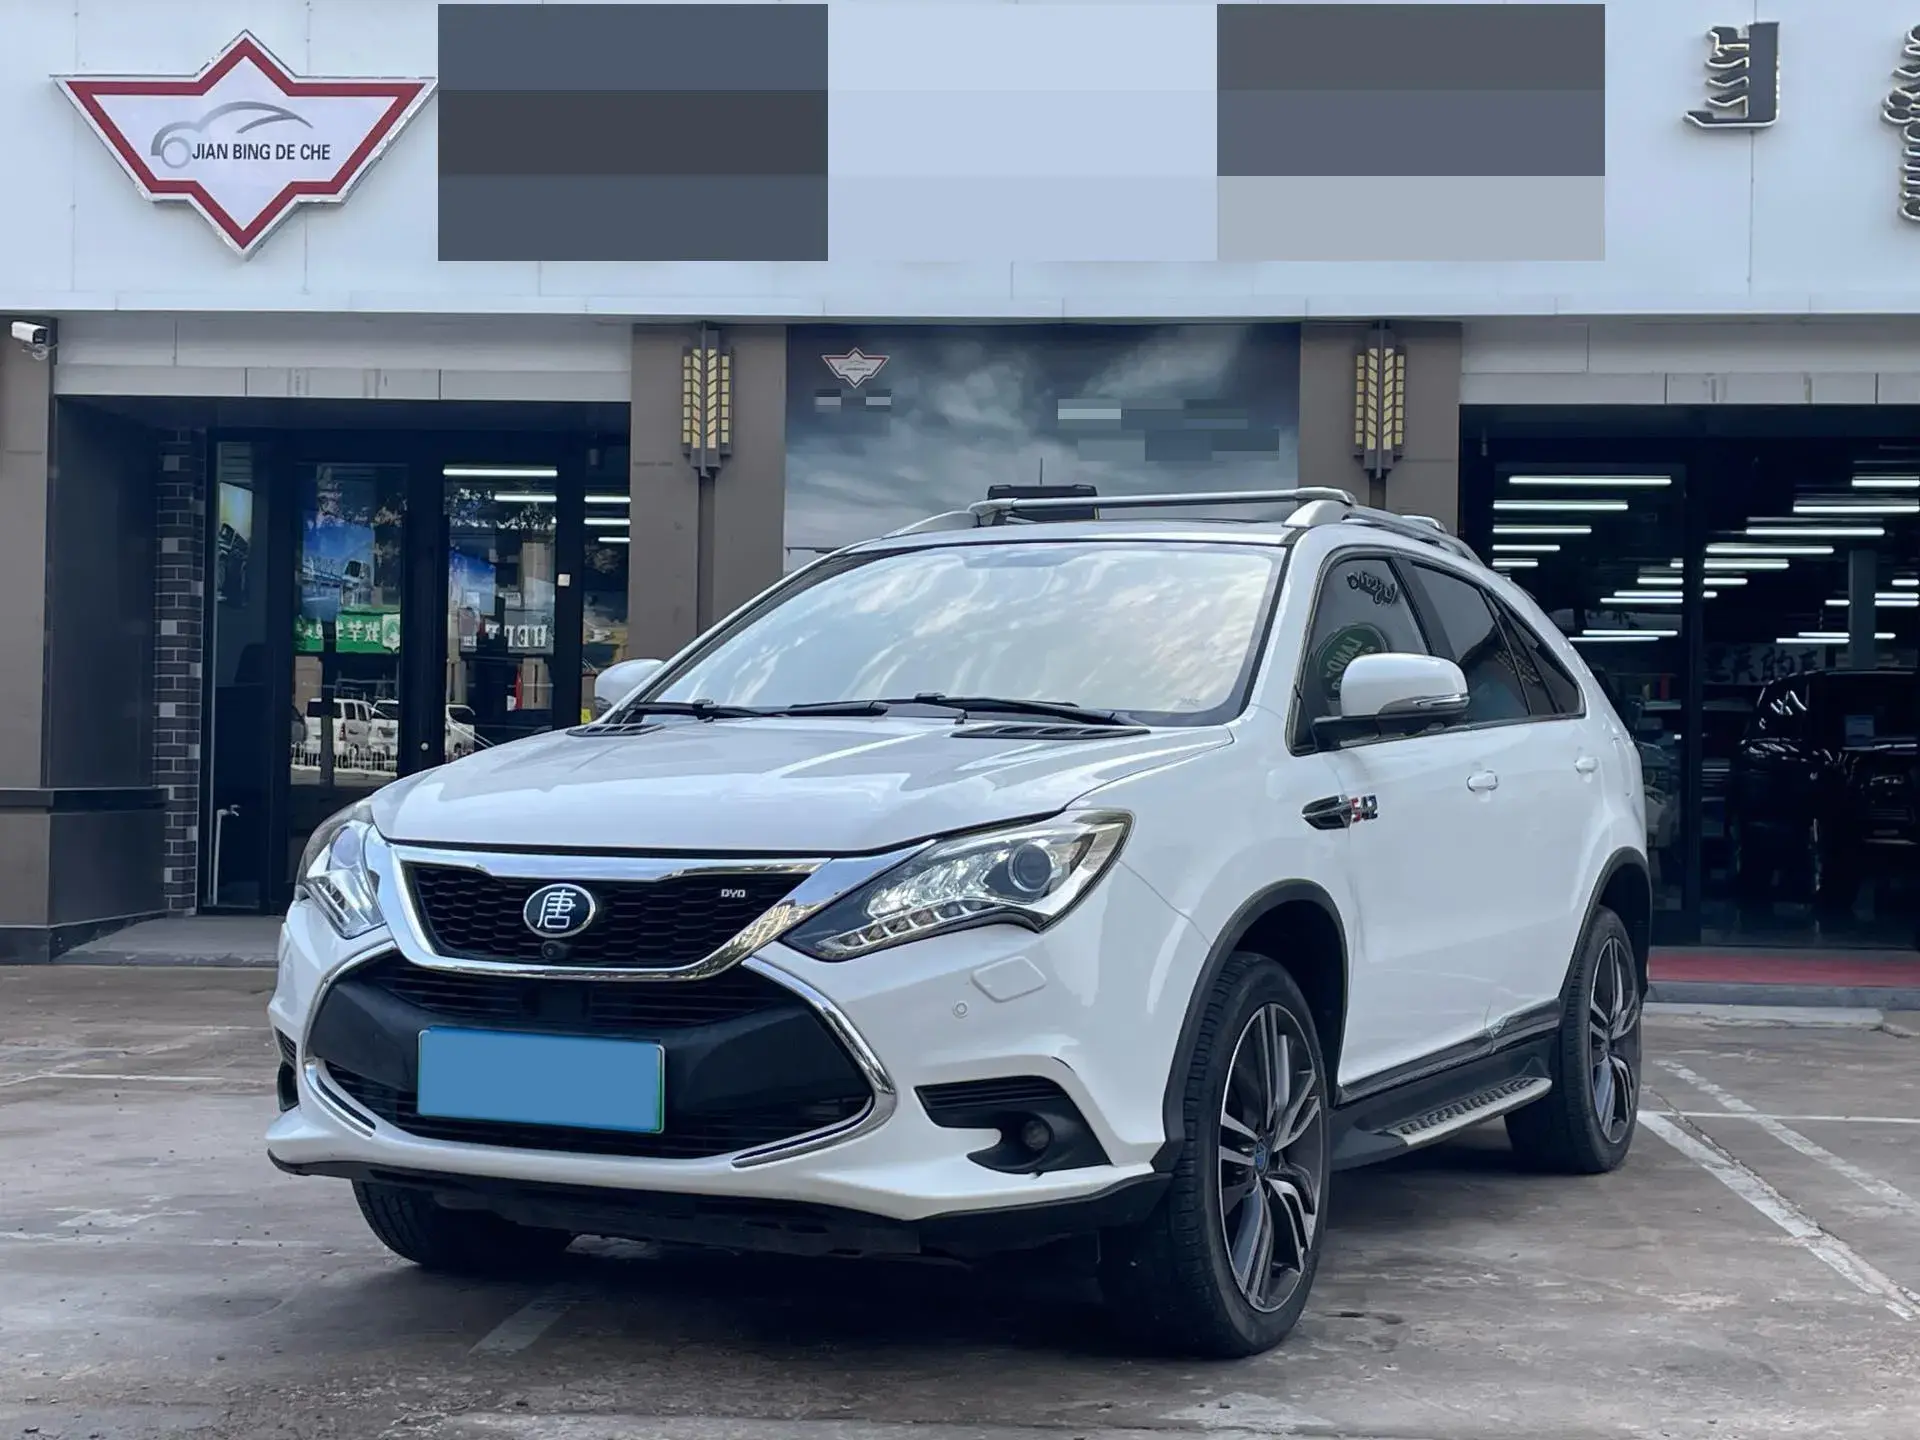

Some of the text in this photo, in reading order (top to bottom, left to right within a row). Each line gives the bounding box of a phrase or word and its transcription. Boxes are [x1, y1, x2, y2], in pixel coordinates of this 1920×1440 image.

[192, 143, 331, 160] JIAN BING DE CHE
[537, 889, 577, 929] 唐
